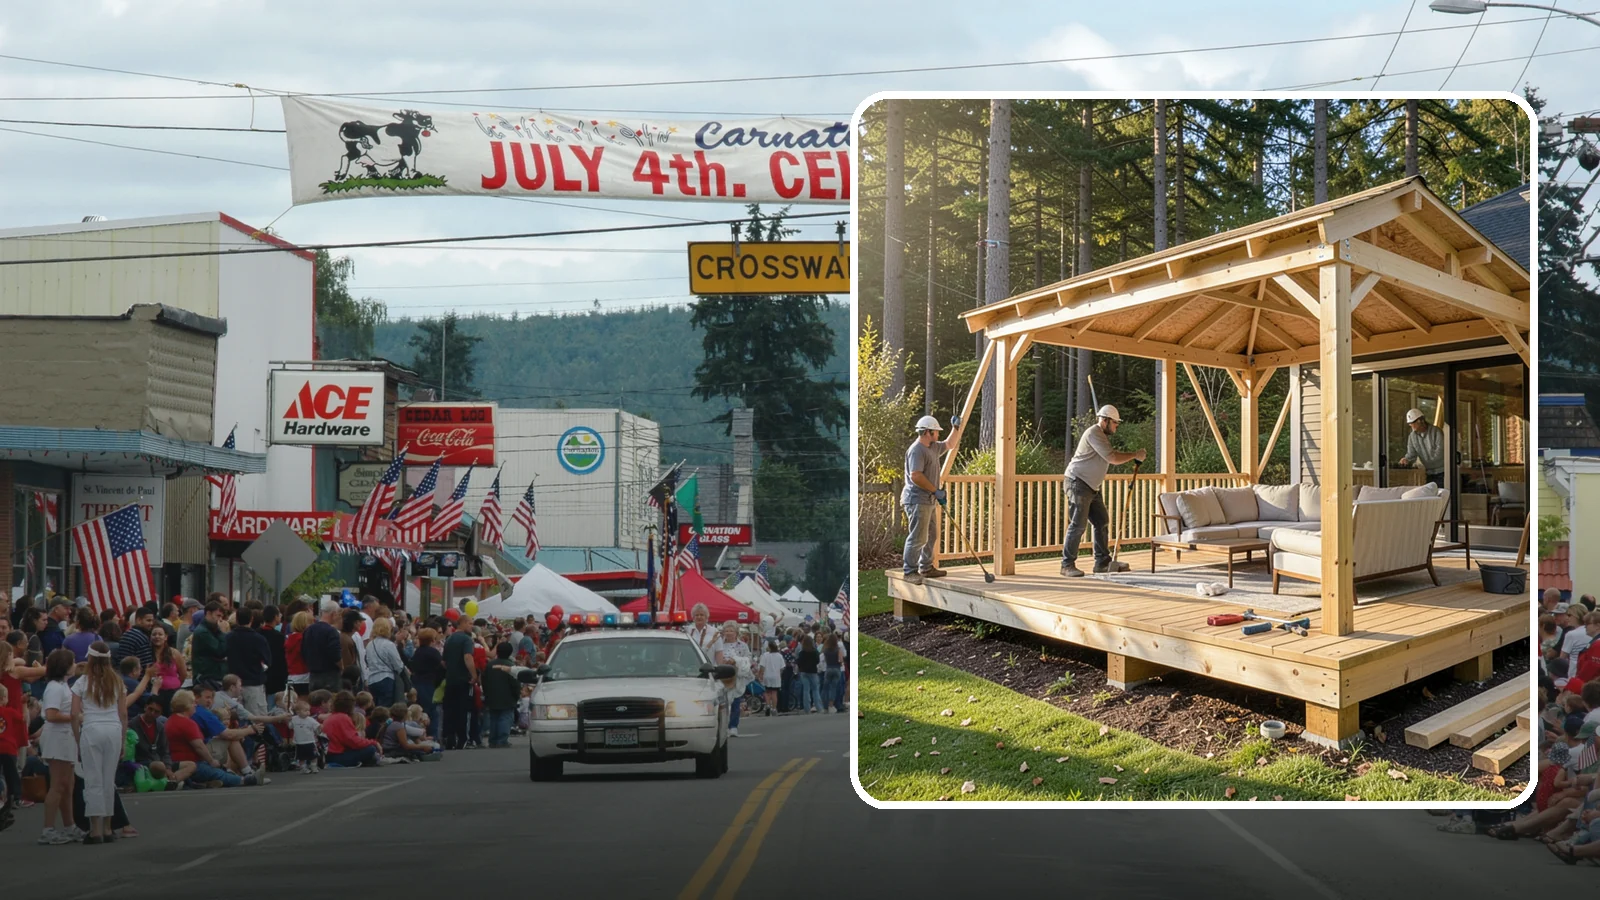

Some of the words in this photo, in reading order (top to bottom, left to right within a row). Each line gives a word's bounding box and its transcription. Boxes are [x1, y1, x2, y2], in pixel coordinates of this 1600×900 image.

[481, 141, 605, 193] JULY
[632, 150, 746, 198] 4th.
[697, 254, 850, 280] CROSSWA
[283, 380, 373, 420] ACE
[406, 410, 452, 422] CEDAR
[283, 421, 371, 436] Hardware
[416, 428, 476, 447] Coca-Cola
[83, 485, 94, 494] St.
[96, 486, 124, 495] Vincent
[126, 486, 136, 495] de
[138, 486, 155, 495] Paul
[688, 526, 742, 535] CRNATION
[699, 535, 730, 543] GLASS
